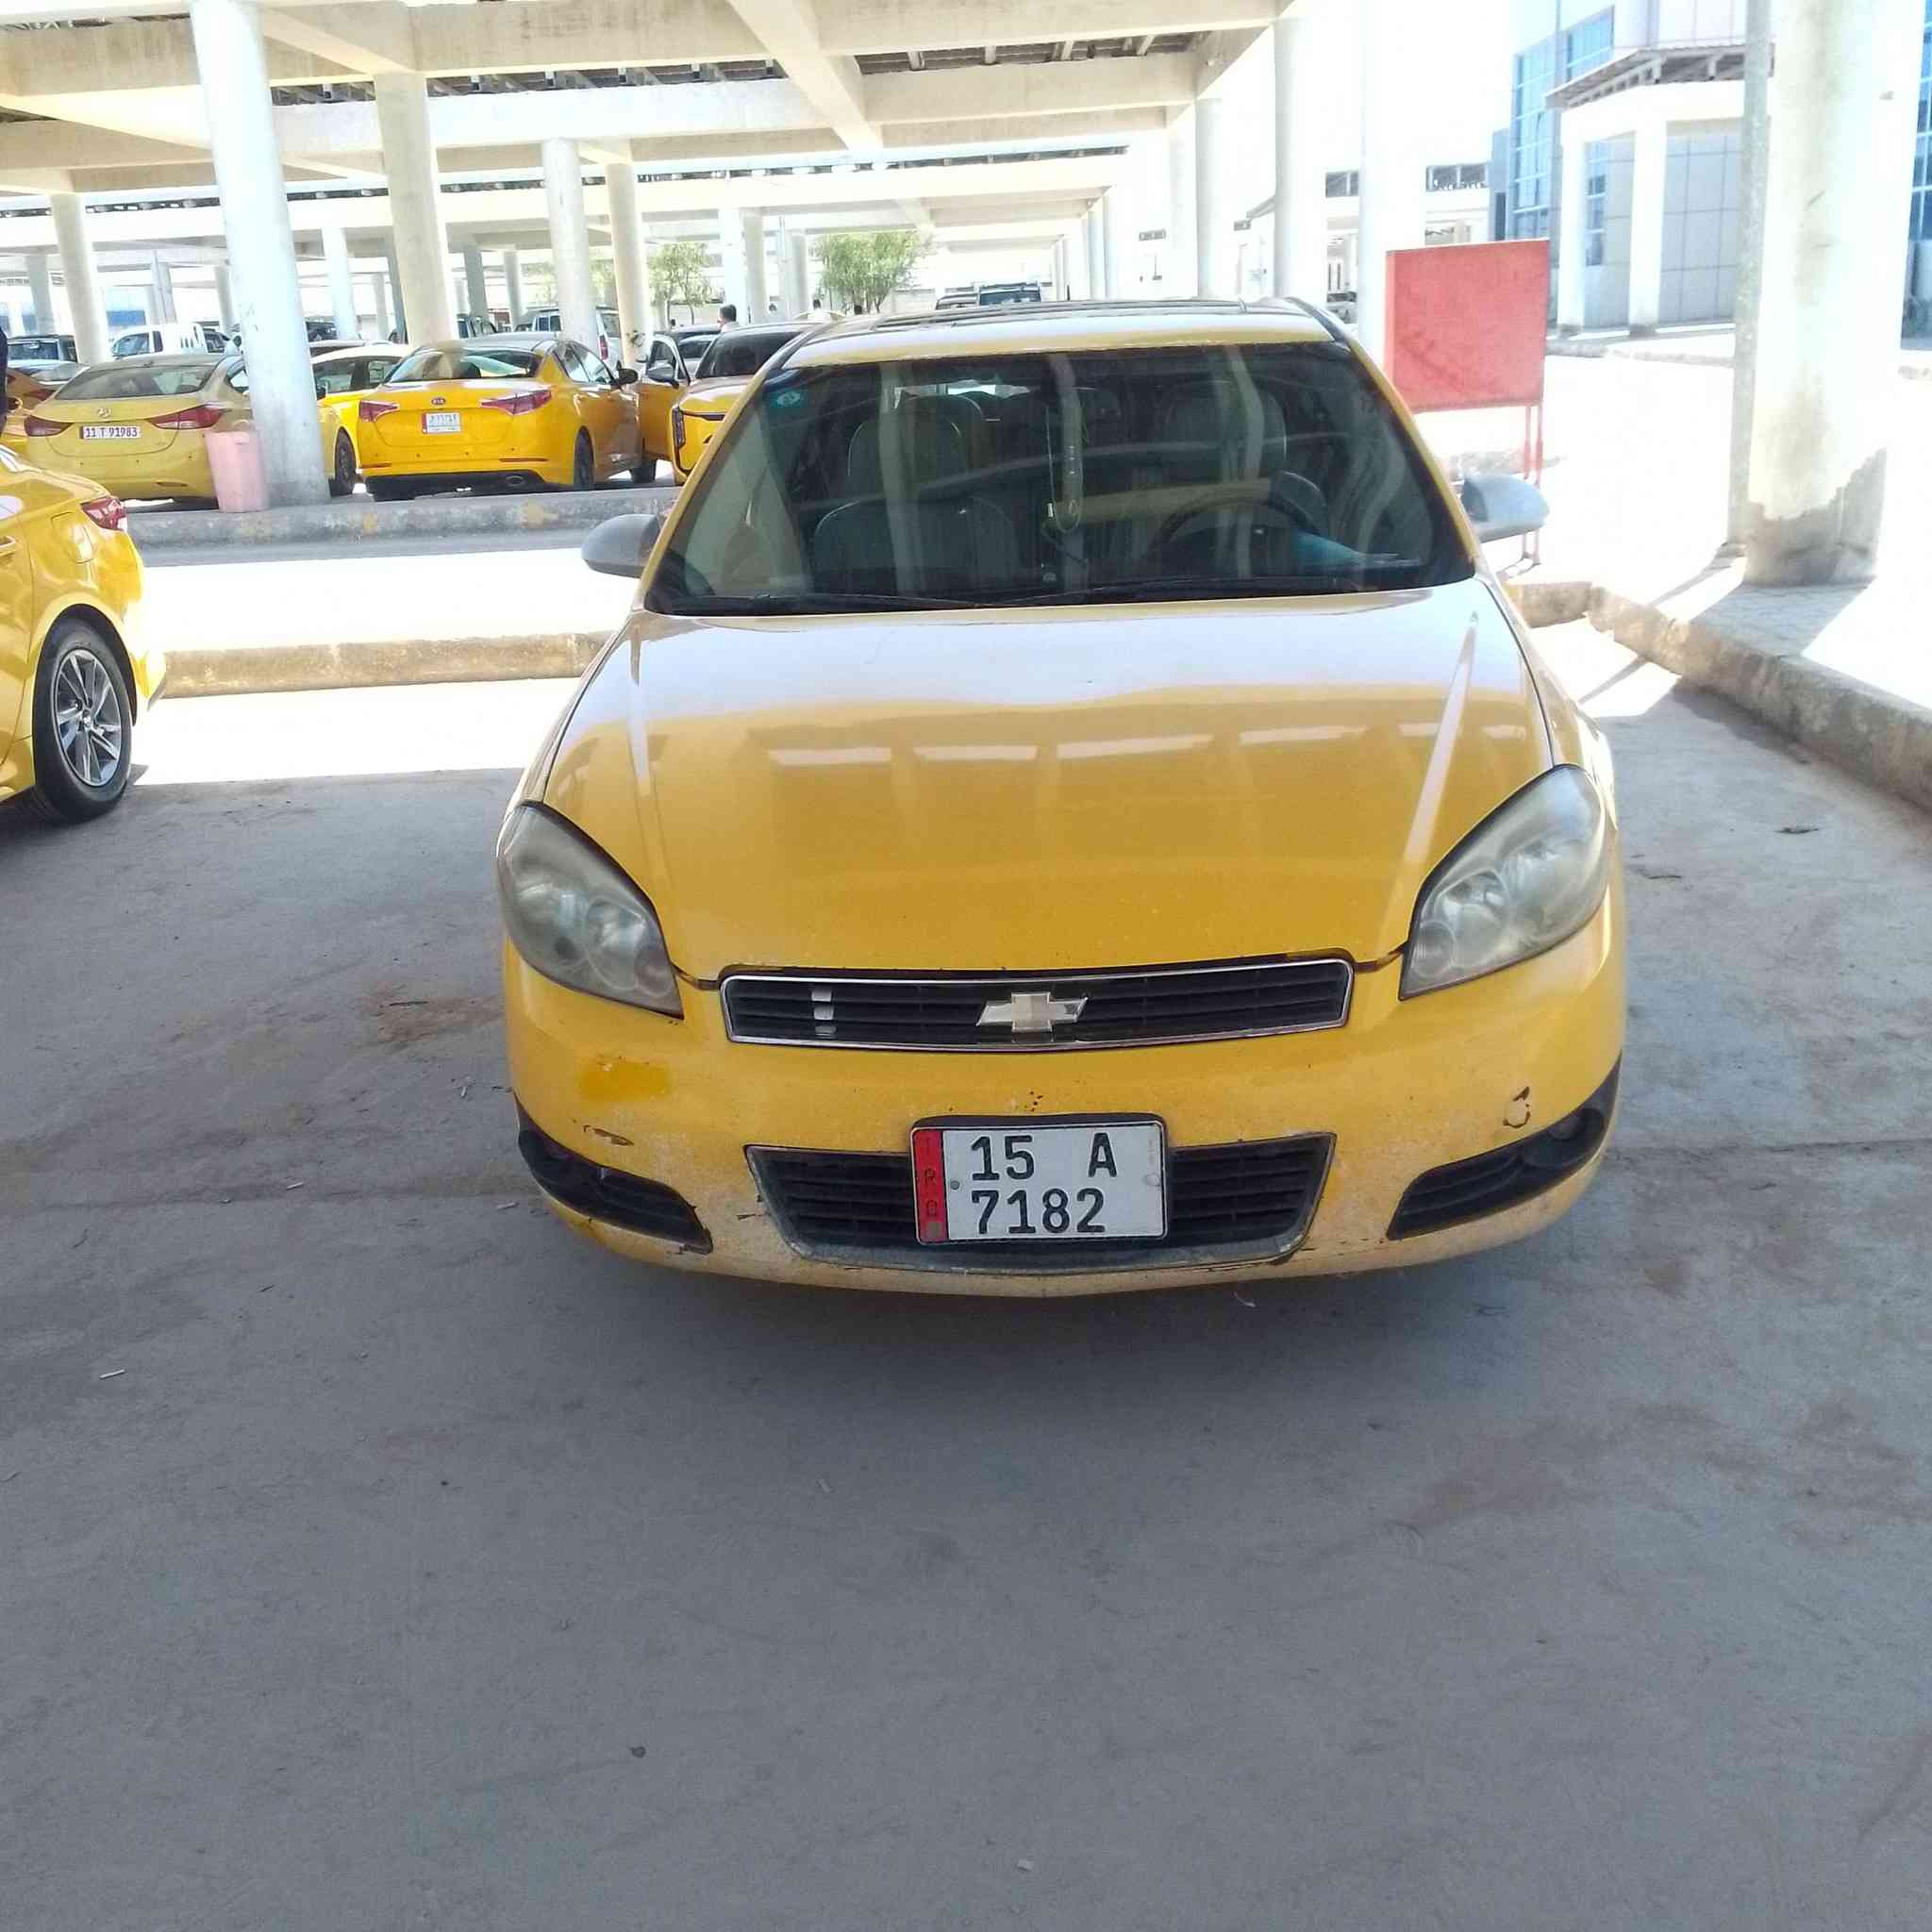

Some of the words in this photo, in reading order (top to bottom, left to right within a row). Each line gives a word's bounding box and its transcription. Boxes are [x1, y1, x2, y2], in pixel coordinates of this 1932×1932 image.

[86, 427, 96, 438] 11
[99, 427, 107, 437] T
[108, 427, 138, 437] 91983
[971, 1135, 1035, 1181] 15
[1088, 1132, 1118, 1177] A
[971, 1188, 1106, 1235] 7182
